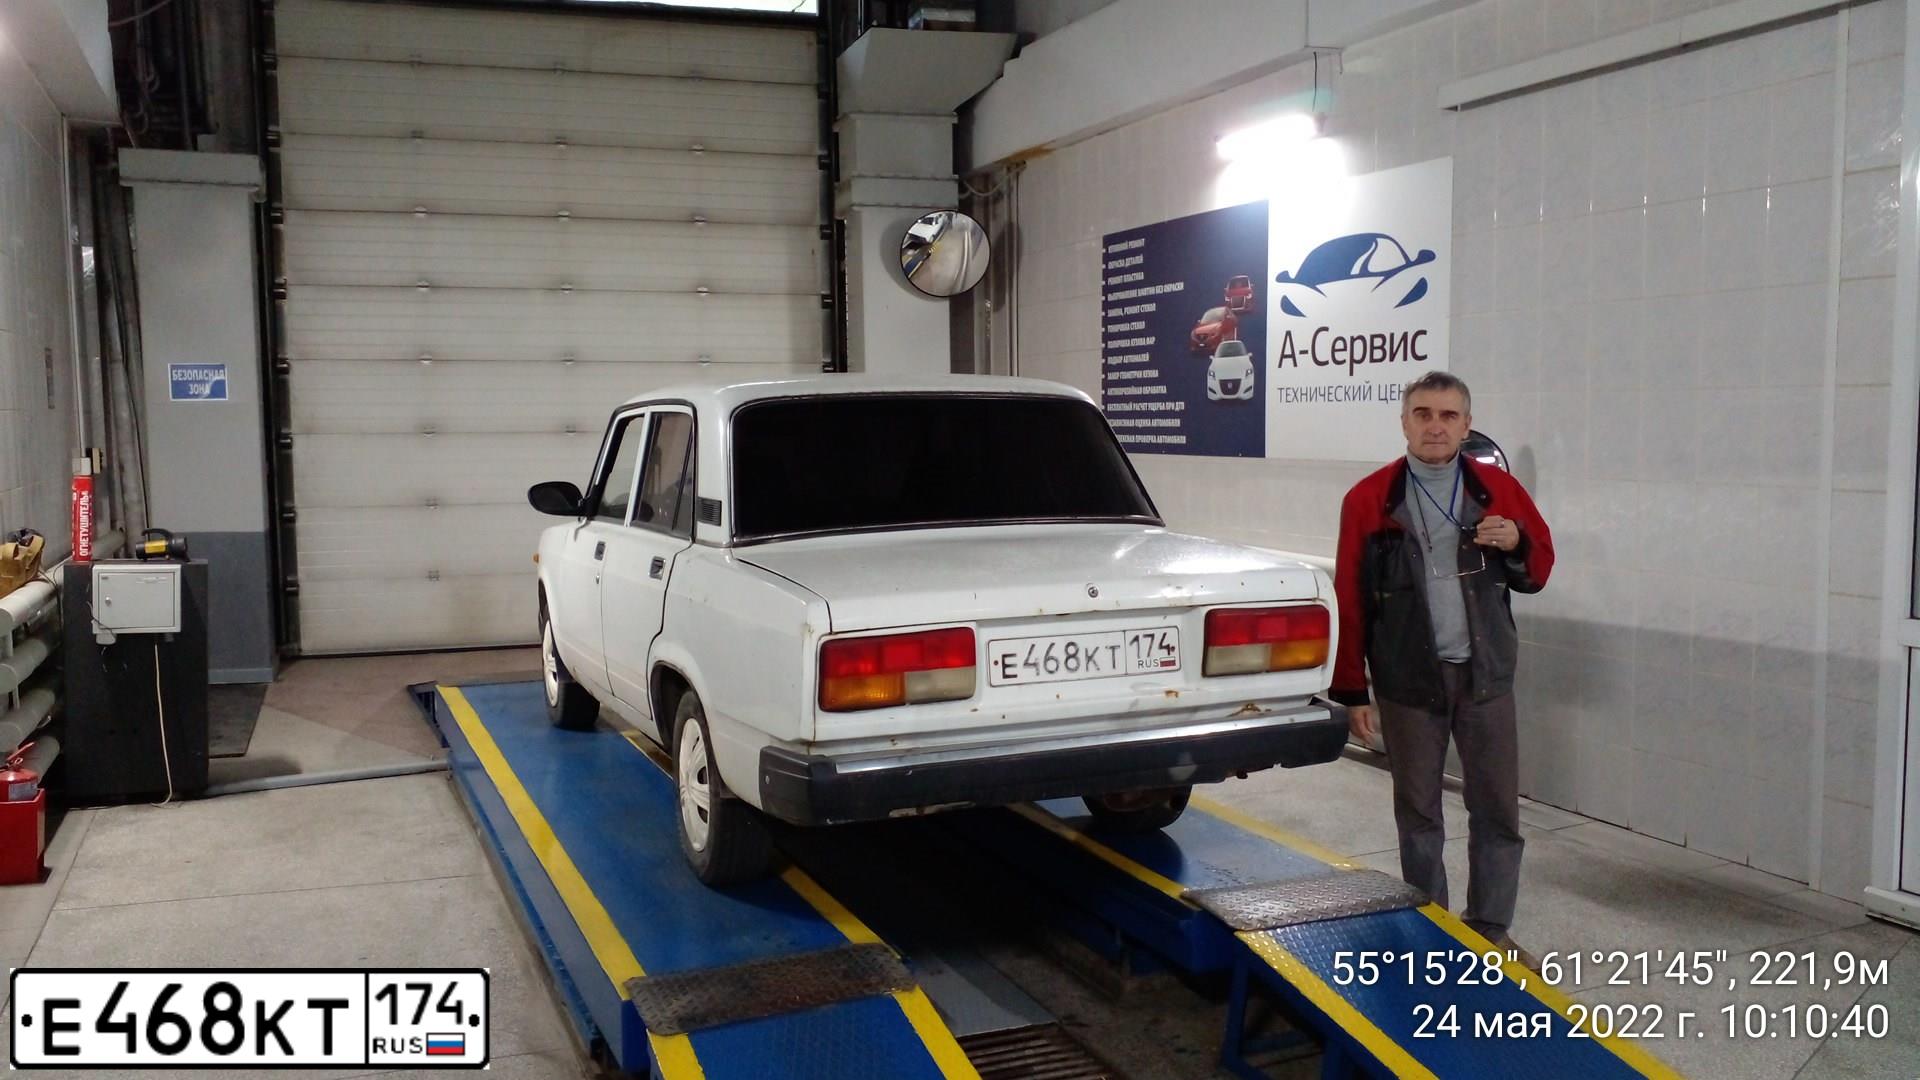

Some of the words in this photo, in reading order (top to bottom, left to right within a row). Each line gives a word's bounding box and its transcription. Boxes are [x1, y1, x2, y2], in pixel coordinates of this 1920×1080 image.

[1277, 326, 1428, 376] А-Сервис
[172, 369, 225, 381] БЕЗОПАСНАЯ
[188, 383, 210, 395] ЗОНА
[1277, 380, 1372, 403] ТЕХНИЧЕСКИЙ
[1378, 382, 1407, 404] ЦЕН
[79, 491, 89, 556] ОГНЕТУШИТЕЛЬ
[1129, 632, 1172, 659] 174
[1138, 659, 1160, 669] RUS
